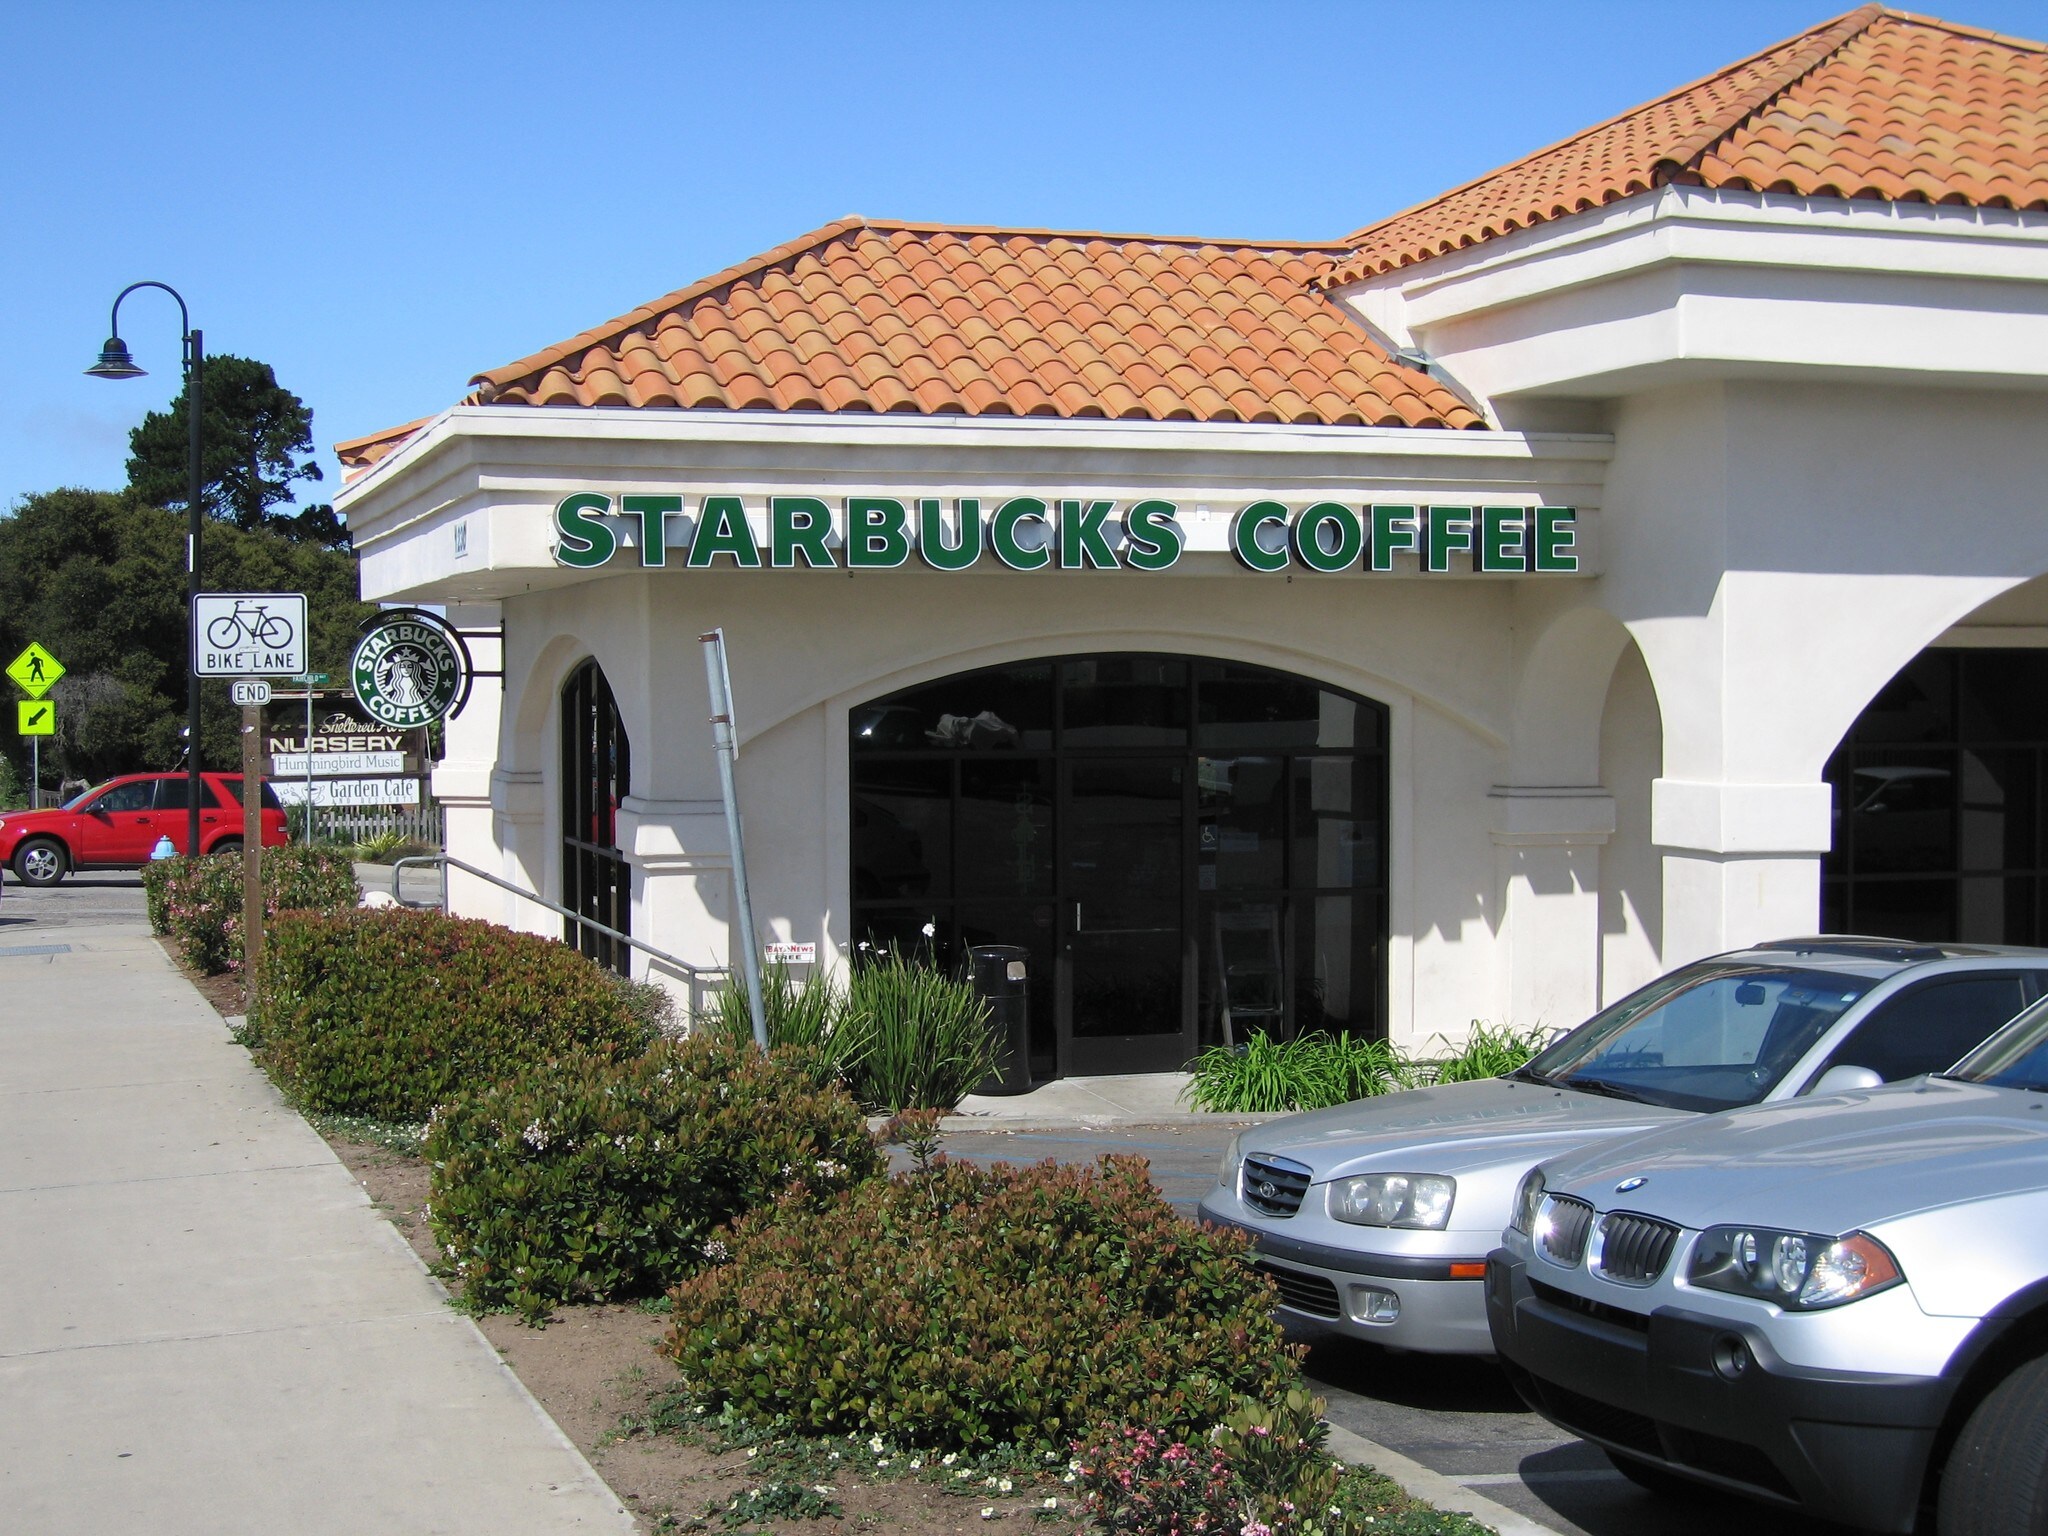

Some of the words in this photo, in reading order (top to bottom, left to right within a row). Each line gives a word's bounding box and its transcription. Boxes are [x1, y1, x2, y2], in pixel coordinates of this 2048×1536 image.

[553, 491, 1183, 572] STARBUCKS
[1231, 499, 1579, 572] COFFEE
[358, 626, 454, 673] STARBUCKS
[207, 653, 243, 668] BIKE
[253, 653, 294, 668] LANE
[237, 686, 266, 700] END
[369, 695, 444, 722] COFFEE
[319, 713, 376, 733] Sheltered
[269, 736, 402, 752] NURSERY
[278, 756, 361, 771] Hummingbird
[366, 755, 400, 768] Music
[330, 780, 378, 798] Garden
[385, 779, 413, 796] Café
[790, 944, 814, 952] NEWS
